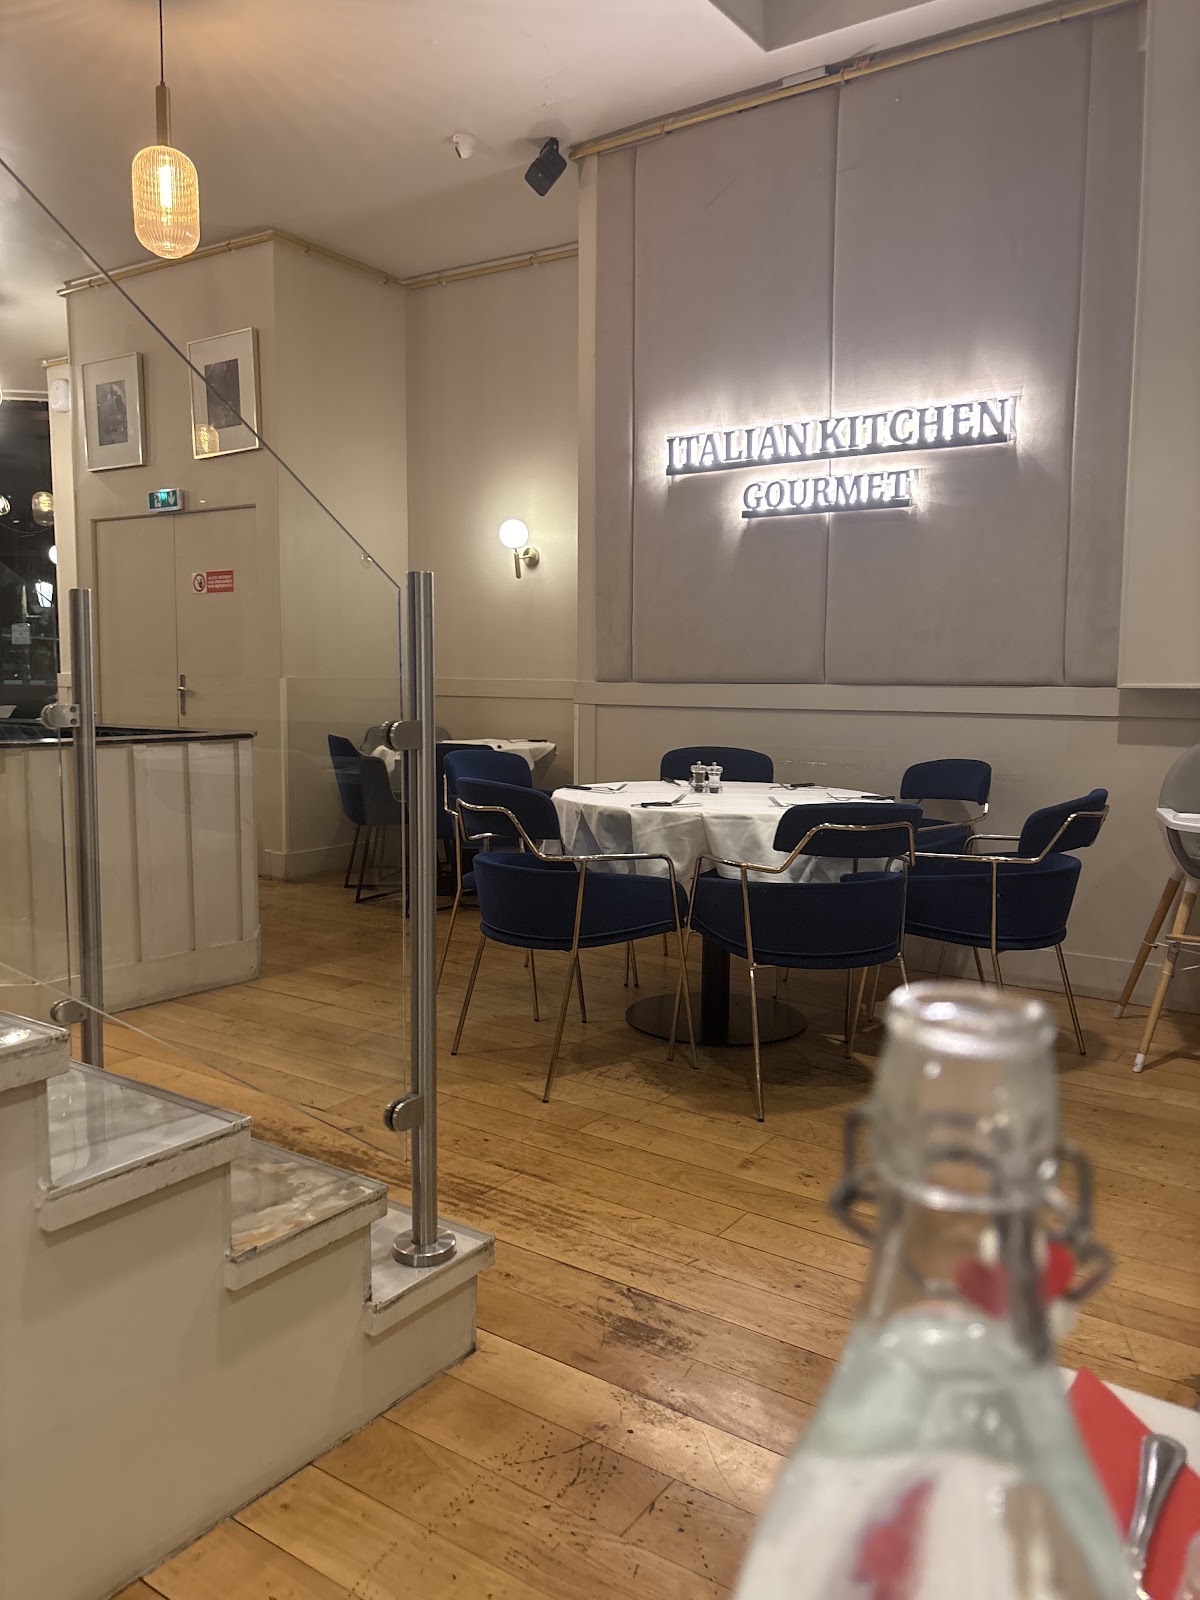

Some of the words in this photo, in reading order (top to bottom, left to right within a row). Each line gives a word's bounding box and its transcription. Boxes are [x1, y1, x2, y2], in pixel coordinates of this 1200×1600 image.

[666, 422, 811, 468] ITALIAN
[818, 398, 1010, 452] KITCHEN
[742, 470, 911, 511] GOURMET
